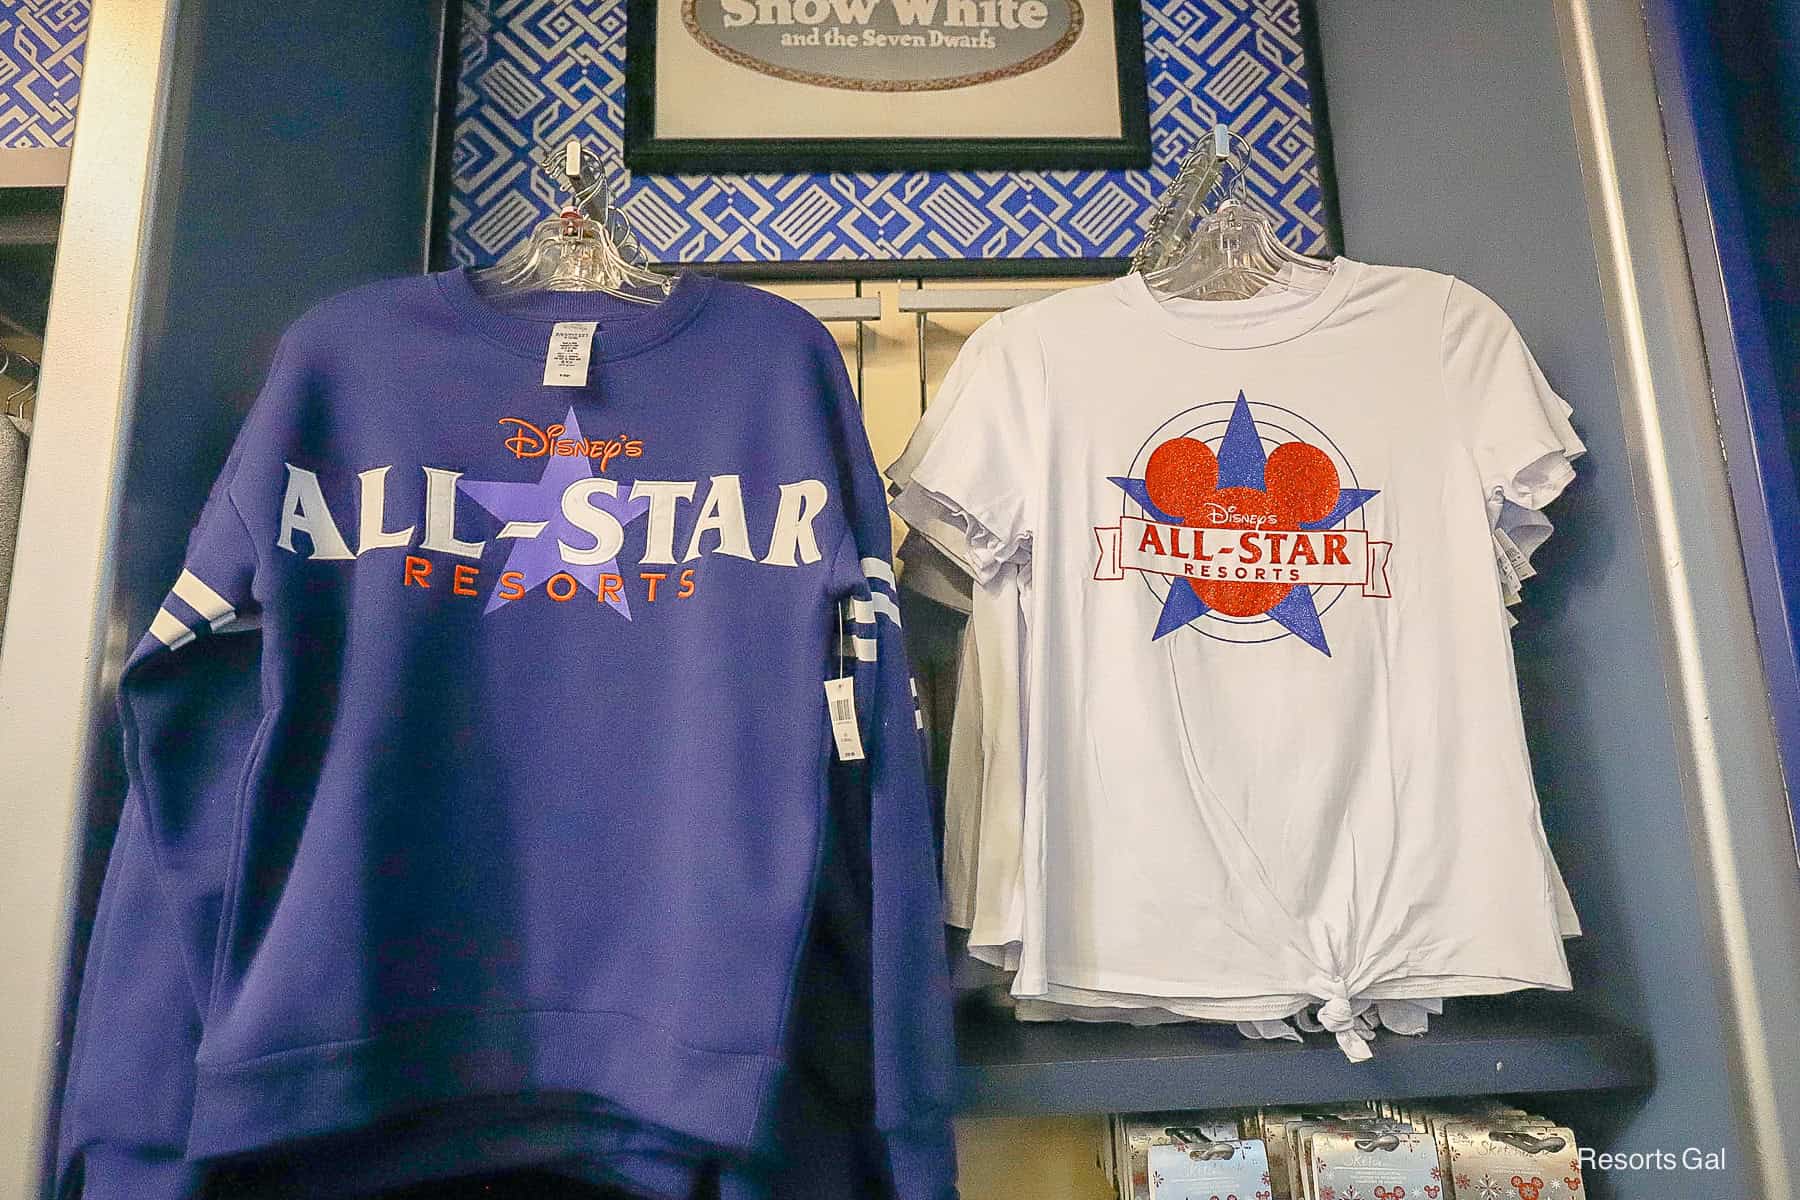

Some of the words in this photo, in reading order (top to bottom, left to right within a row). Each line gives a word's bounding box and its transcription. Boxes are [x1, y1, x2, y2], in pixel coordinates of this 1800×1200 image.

[721, 0, 877, 27] Snow
[891, 0, 1049, 29] White
[781, 28, 820, 47] and
[823, 28, 859, 47] the
[863, 30, 927, 48] Seven
[928, 30, 996, 49] Dwarfs
[498, 417, 643, 473] Disney's
[276, 462, 828, 567] ALL-STAR
[1138, 524, 1352, 566] ALL-STAR
[404, 556, 695, 603] RESORTS
[1184, 563, 1300, 580] RESORTS
